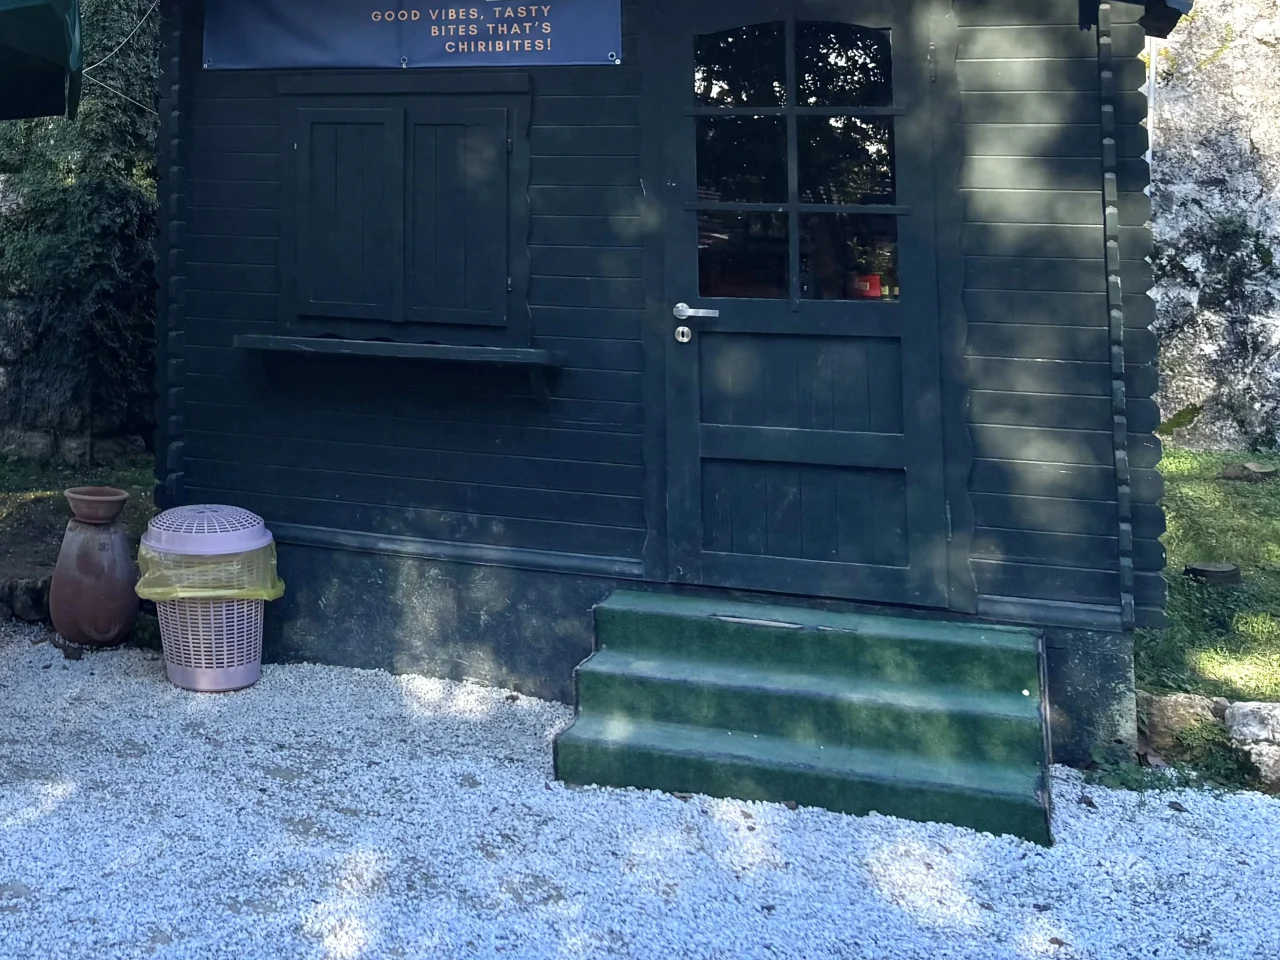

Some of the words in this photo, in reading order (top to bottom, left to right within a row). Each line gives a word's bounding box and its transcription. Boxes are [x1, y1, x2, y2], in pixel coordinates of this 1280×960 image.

[371, 10, 420, 22] GOOD
[429, 8, 484, 20] VIBES,
[493, 6, 551, 18] TASTY
[431, 24, 478, 36] BITES
[487, 22, 551, 35] THAT'S
[445, 39, 551, 53] CHIRIBITES!
